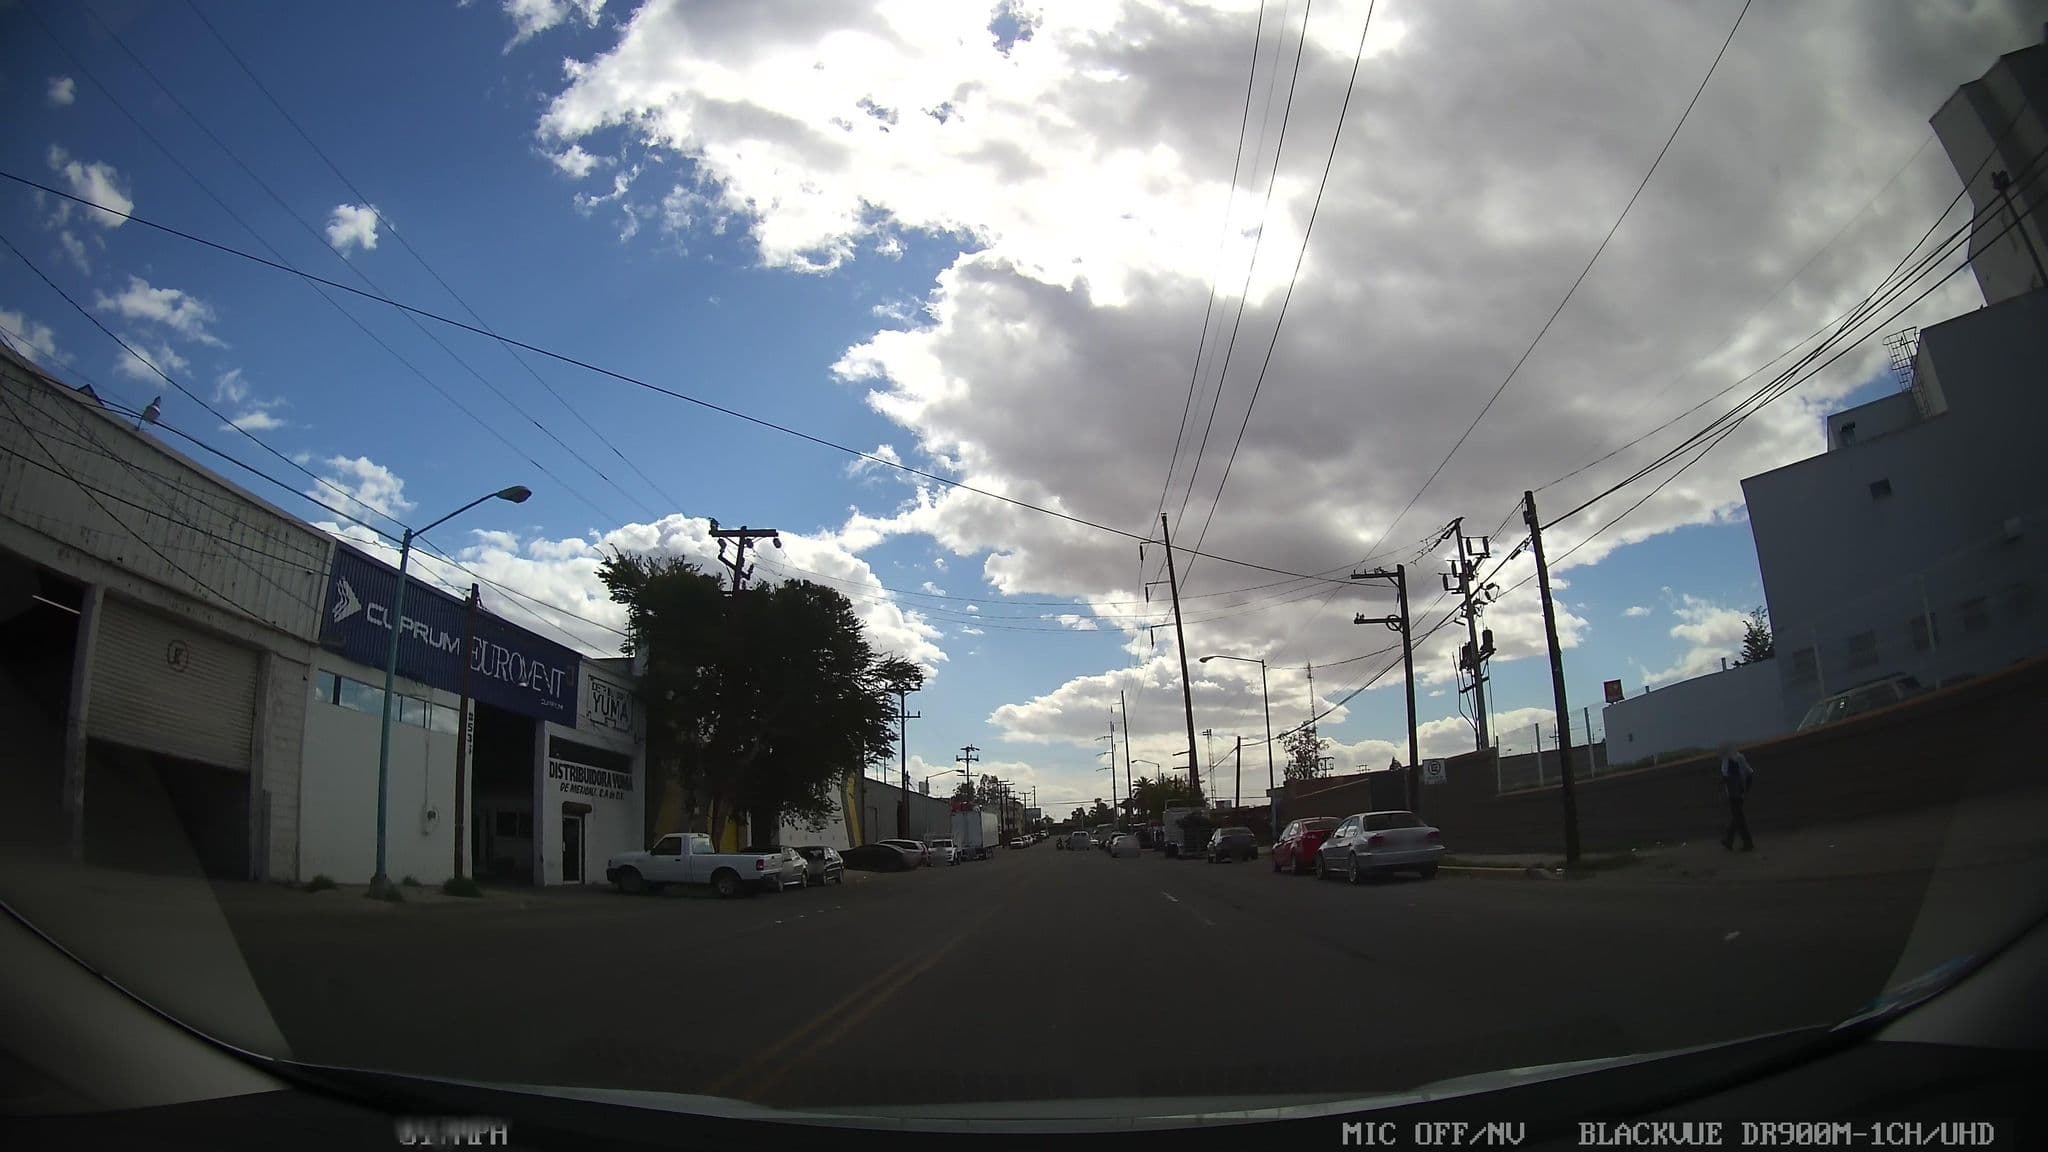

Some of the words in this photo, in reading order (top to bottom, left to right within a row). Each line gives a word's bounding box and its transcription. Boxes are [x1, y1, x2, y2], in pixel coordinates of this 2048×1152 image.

[470, 635, 566, 699] EUROVENT
[592, 691, 629, 722] YUMA
[549, 761, 612, 787] DISTRIBUIDORA
[560, 782, 570, 793] DE
